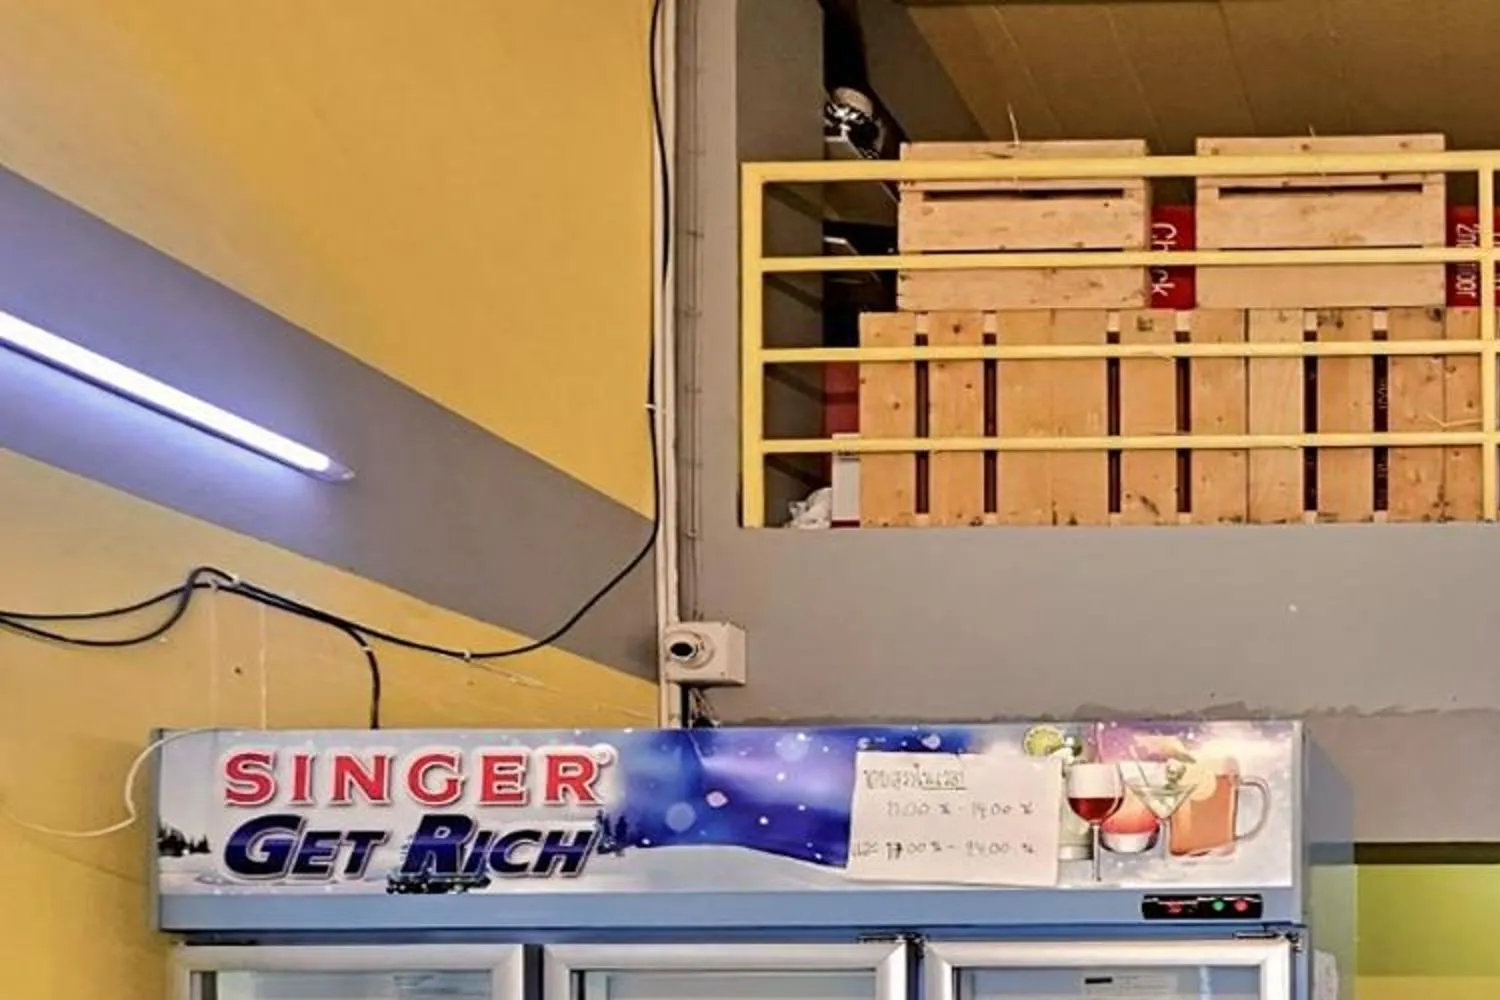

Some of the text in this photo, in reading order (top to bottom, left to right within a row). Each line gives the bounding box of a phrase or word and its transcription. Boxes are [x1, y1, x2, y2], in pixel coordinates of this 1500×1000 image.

[1152, 223, 1177, 297] Chck
[224, 752, 598, 805] SINGER
[223, 813, 600, 879] GET RICH
